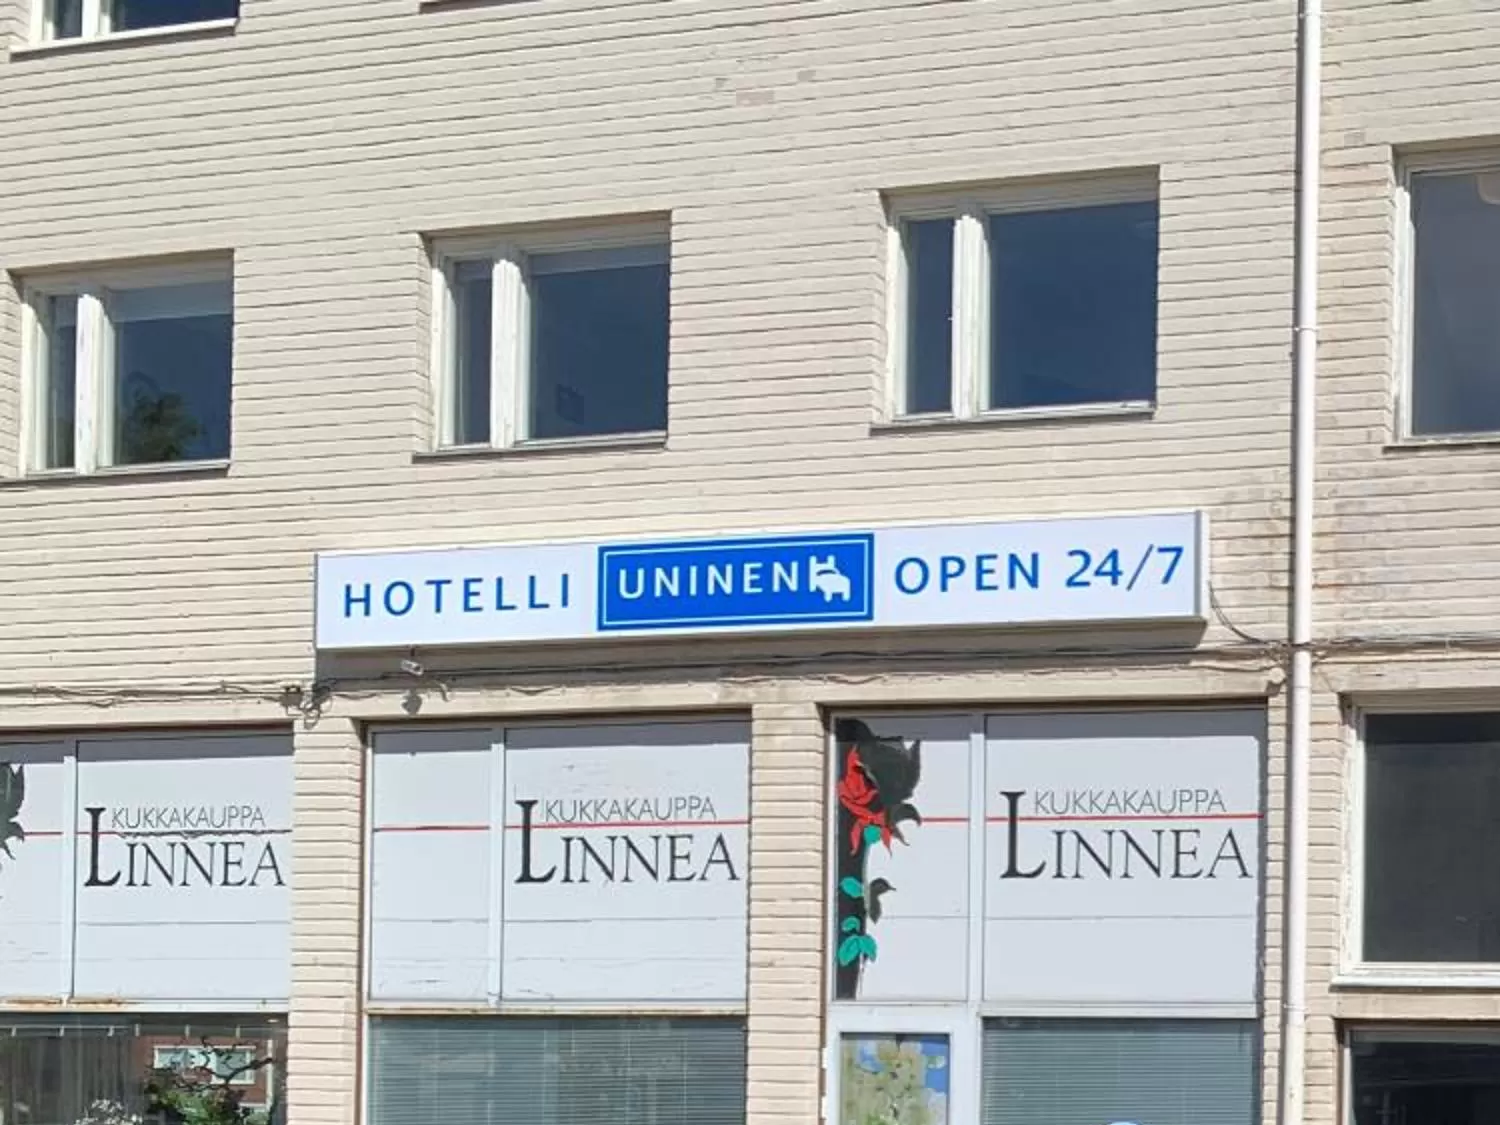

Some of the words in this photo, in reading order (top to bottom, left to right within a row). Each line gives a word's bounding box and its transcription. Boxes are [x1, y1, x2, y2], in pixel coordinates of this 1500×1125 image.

[343, 573, 570, 618] HOTELLI
[618, 561, 799, 599] UNINEN
[894, 552, 1040, 595] OPEN
[1064, 543, 1185, 591] 24/7
[111, 804, 266, 830] KUKKAKAUPPA
[544, 796, 717, 823] KUKKAKAUPPA
[1000, 790, 1253, 880] LINNEA
[1033, 788, 1226, 815] KUKKAKAUPPA
[84, 807, 286, 887] LINNEA
[515, 799, 741, 885] LINNEA
